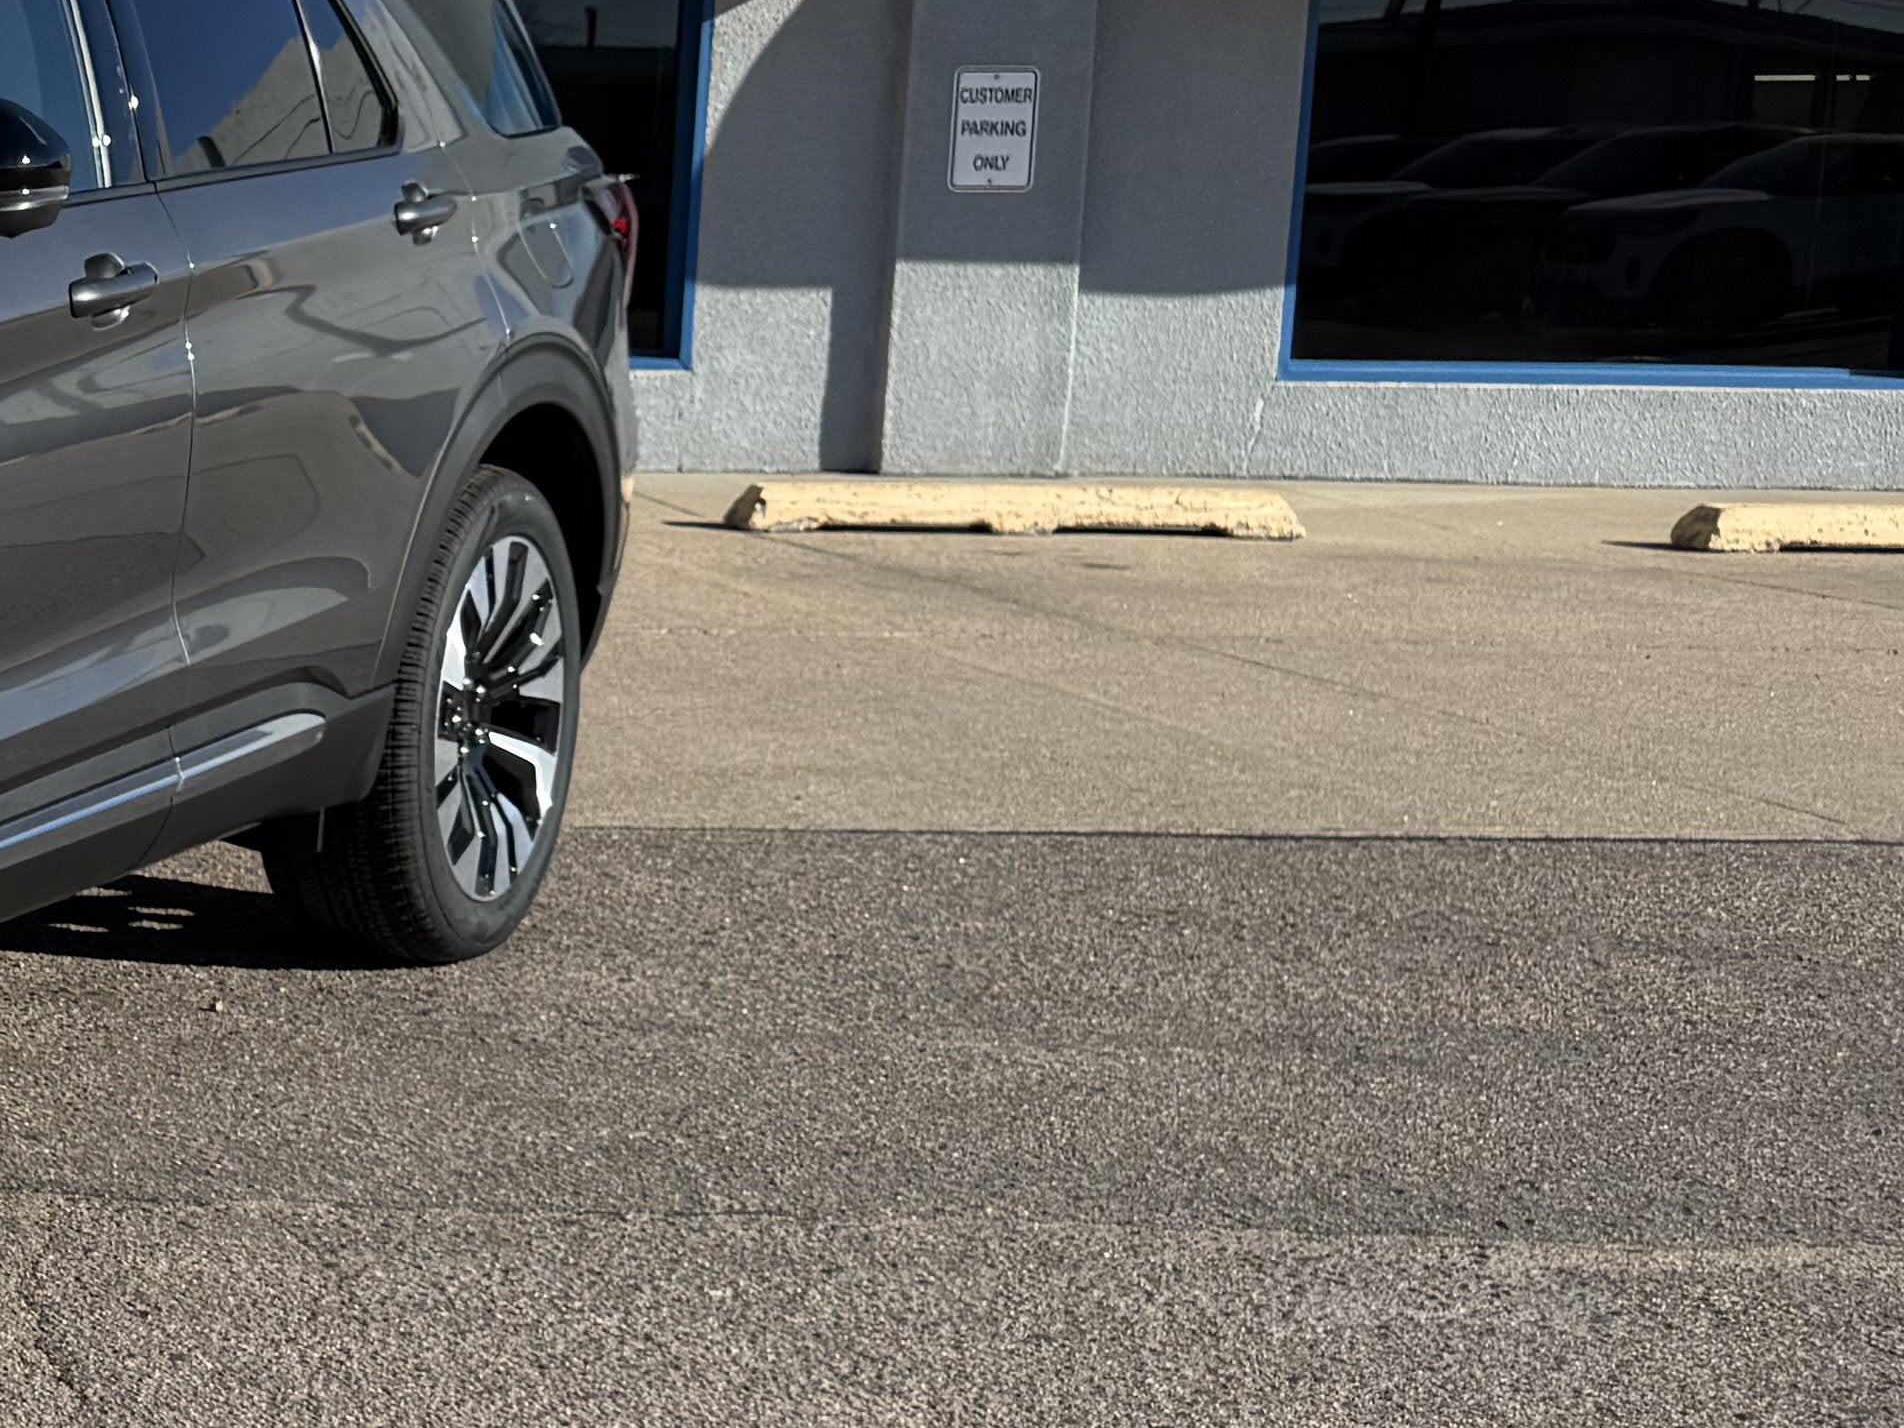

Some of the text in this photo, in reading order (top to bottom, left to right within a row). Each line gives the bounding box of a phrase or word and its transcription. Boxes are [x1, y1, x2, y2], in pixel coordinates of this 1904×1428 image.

[960, 87, 1033, 104] CUSTOMER
[961, 120, 1026, 137] PARKING
[973, 154, 1010, 172] ONLY
